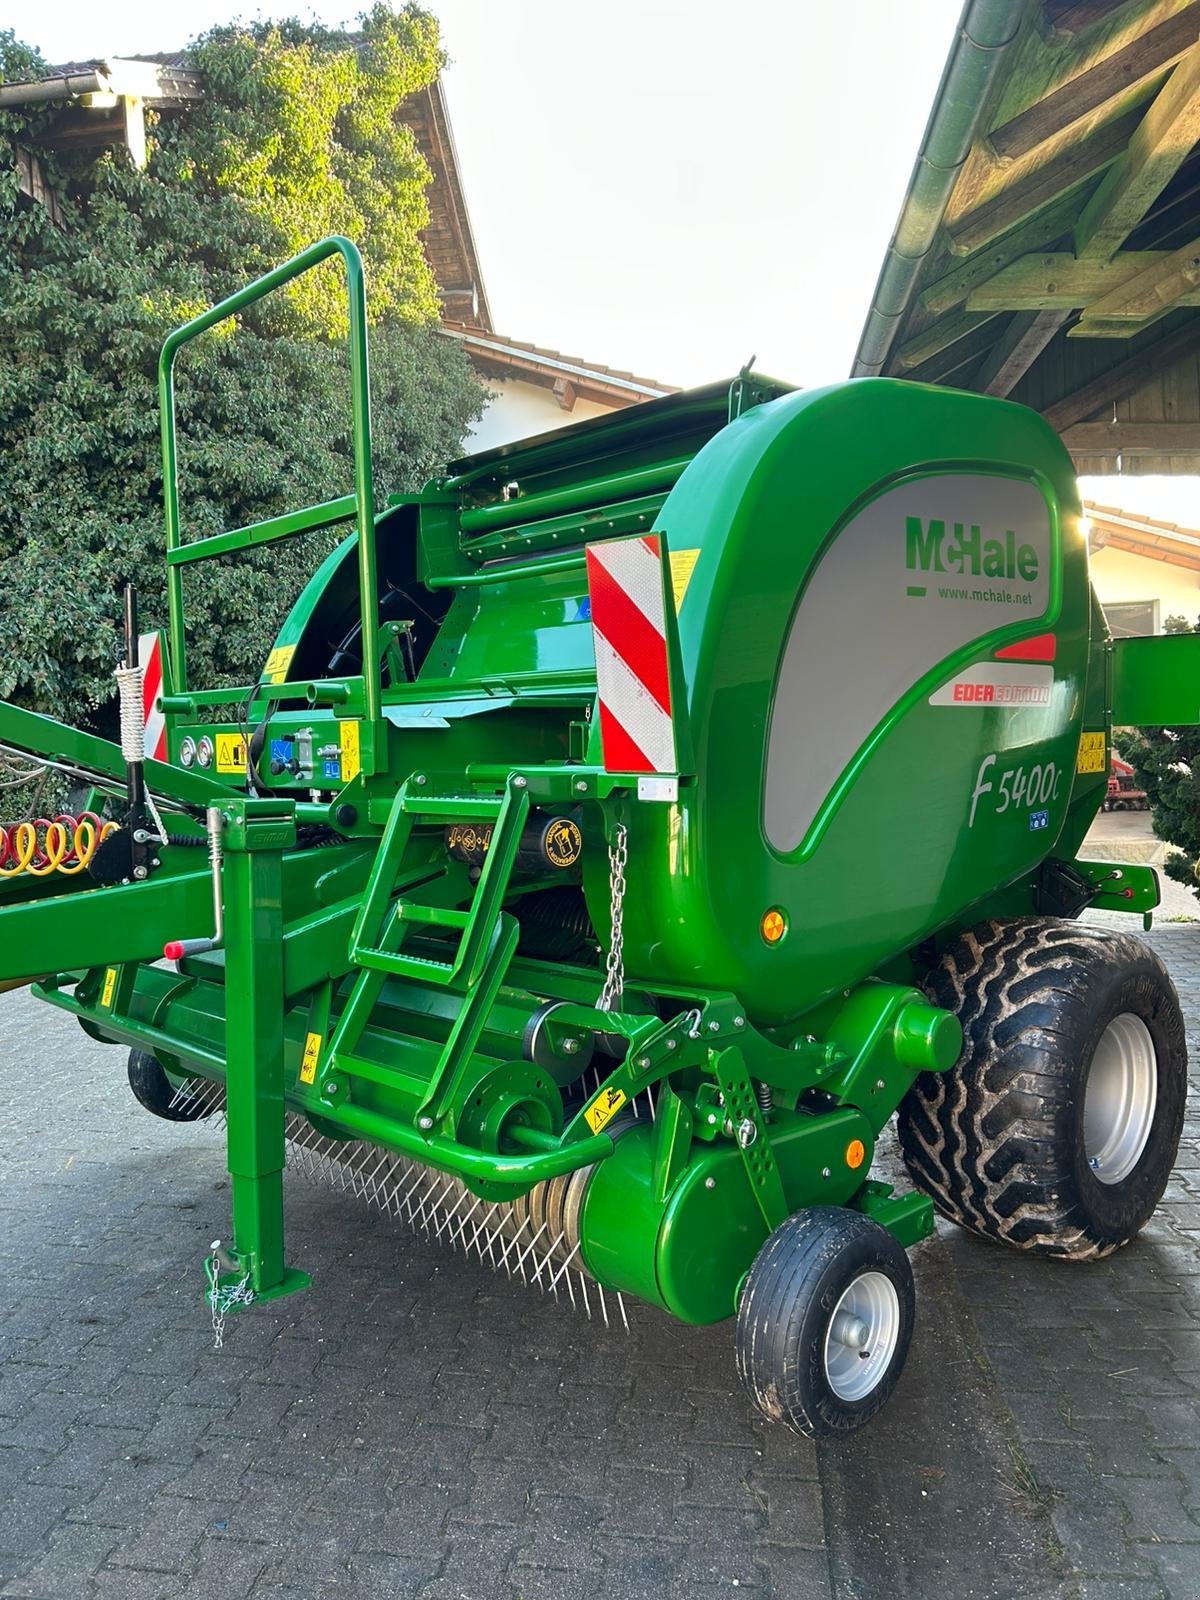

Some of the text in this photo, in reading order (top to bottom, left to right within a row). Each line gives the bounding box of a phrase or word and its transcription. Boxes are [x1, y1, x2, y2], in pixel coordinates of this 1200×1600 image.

[905, 516, 1039, 582] McHale
[938, 587, 1032, 605] www.mchale.net
[953, 683, 994, 702] EDER
